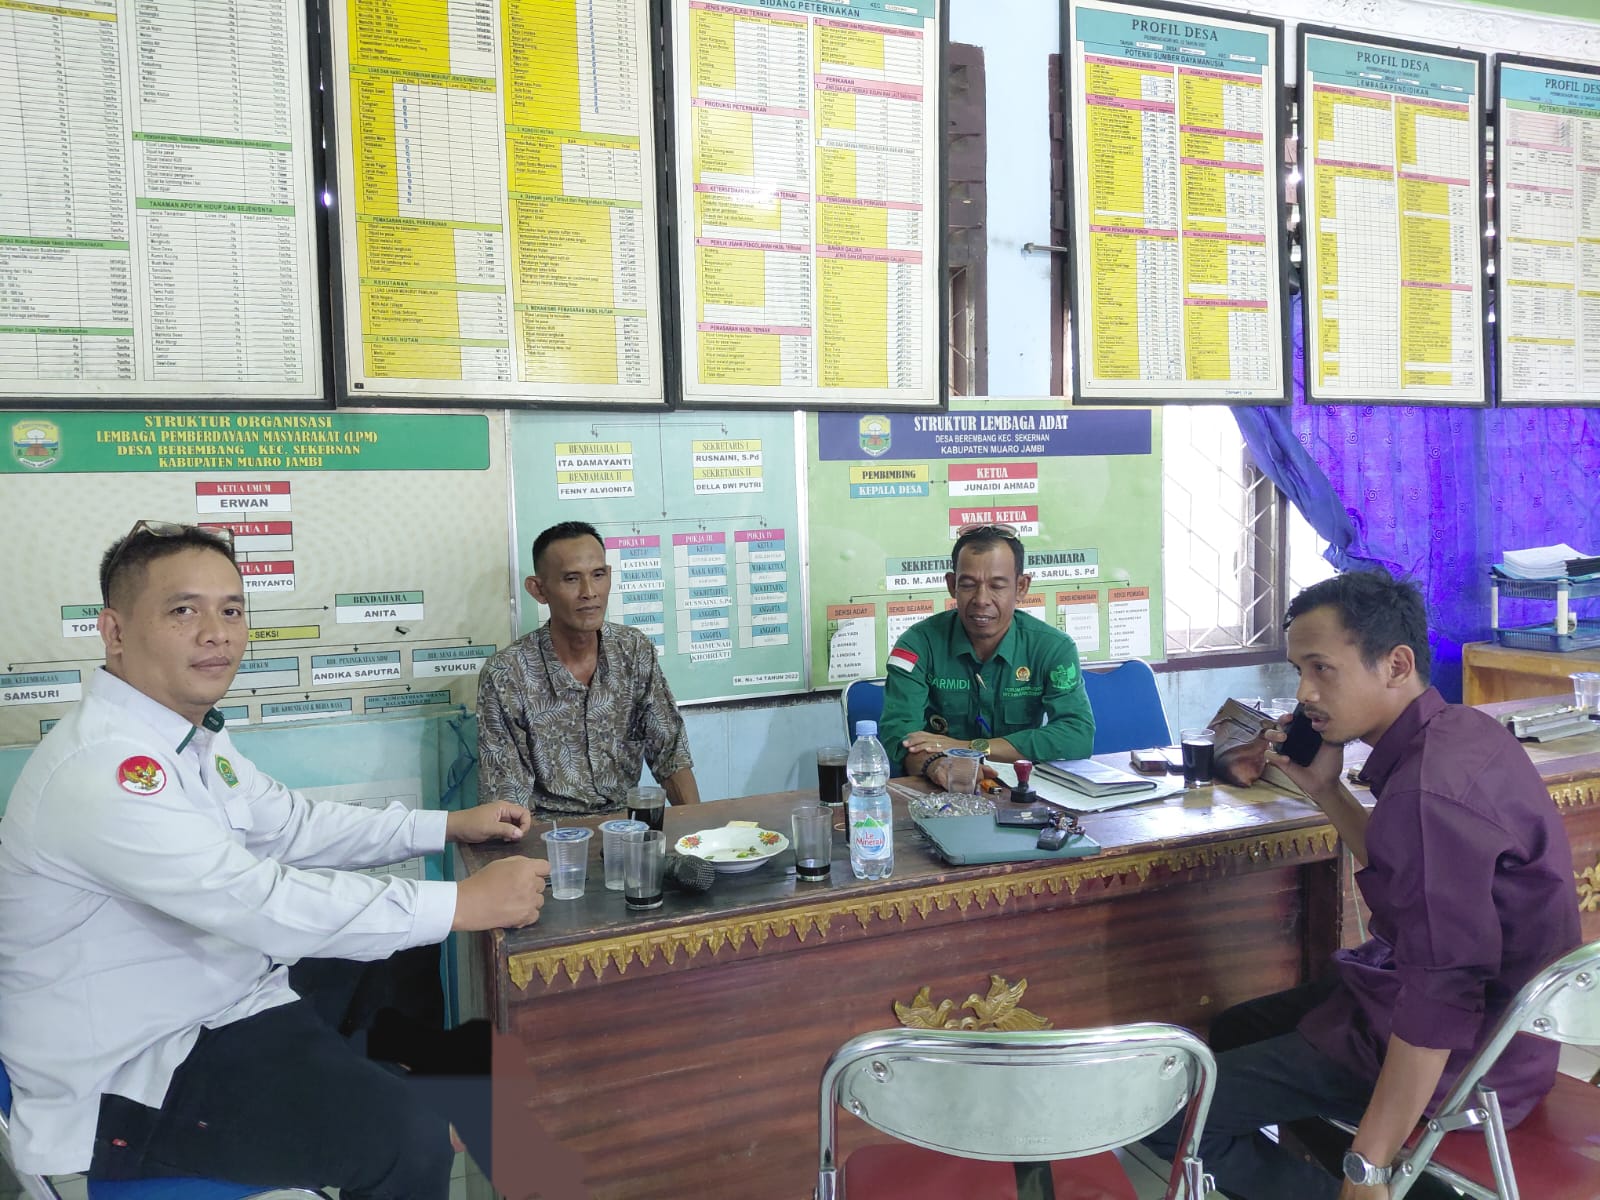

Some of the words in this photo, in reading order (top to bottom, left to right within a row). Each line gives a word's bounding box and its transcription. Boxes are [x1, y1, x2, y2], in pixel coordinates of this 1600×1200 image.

[760, 0, 795, 8] BIDANG
[798, 3, 860, 17] PETERNAKAN
[1132, 19, 1181, 35] PROFIL
[1185, 26, 1218, 41] DESA
[1357, 51, 1398, 67] PROFIL
[1402, 59, 1430, 72] DESA
[1545, 78, 1580, 91] PROFIL
[145, 416, 231, 428] STRUKTUR
[237, 416, 332, 428] ORGANISASI
[914, 416, 976, 432] STRUKTUR
[980, 415, 1037, 431] LEMBAGA
[1039, 415, 1068, 430] ADAT
[97, 430, 156, 443] LEMBAGA
[161, 431, 259, 442] PEMBERDAYAAN
[263, 431, 341, 442] MASYARAKAT
[344, 431, 378, 443] (LPM)
[935, 435, 954, 443] DESA
[954, 435, 996, 443] BEREMBANG
[998, 434, 1013, 442] KEC.
[117, 445, 152, 455] DESA
[158, 445, 244, 455] BEREMBANG
[259, 445, 288, 455] KEC.
[293, 445, 360, 455] SEKERNAN
[702, 442, 743, 451] SEKRETARIS
[941, 445, 988, 454] KABUPATEN
[990, 445, 1019, 453] MUARO
[1021, 445, 1044, 453] JAMBI
[159, 457, 232, 467] KABUPATEN
[238, 457, 281, 467] MUARO
[285, 457, 322, 467] JAMBI
[576, 459, 631, 467] DAMAYANTI
[862, 469, 916, 479] PEMBIMBING
[976, 467, 1008, 478] KETUA
[217, 485, 244, 493] KETUA
[247, 484, 271, 492] UMUM
[590, 486, 633, 494] ALVIONITA
[696, 483, 721, 491] DELLA
[859, 485, 896, 495] KEPALA
[899, 484, 922, 494] DESA
[964, 483, 1001, 491] JUNAIDI
[1003, 481, 1035, 490] AHMAD
[220, 499, 268, 508] ERWAN
[961, 512, 992, 523] WAKIL
[996, 510, 1027, 521] KETUA
[1028, 553, 1086, 565] BENDAHARA
[901, 560, 953, 572] SEKRETAR
[894, 578, 910, 586] RD.
[353, 594, 407, 604] BENDAHARA
[364, 610, 397, 618] ANITA
[72, 624, 99, 632] TOP
[255, 630, 279, 638] SEKSI
[434, 663, 477, 672] SYUKUR
[314, 671, 352, 681] ANDIKA
[354, 667, 400, 678] SAPUTRA
[927, 674, 970, 690] SARMIDI
[4, 690, 59, 700] SAMSURI
